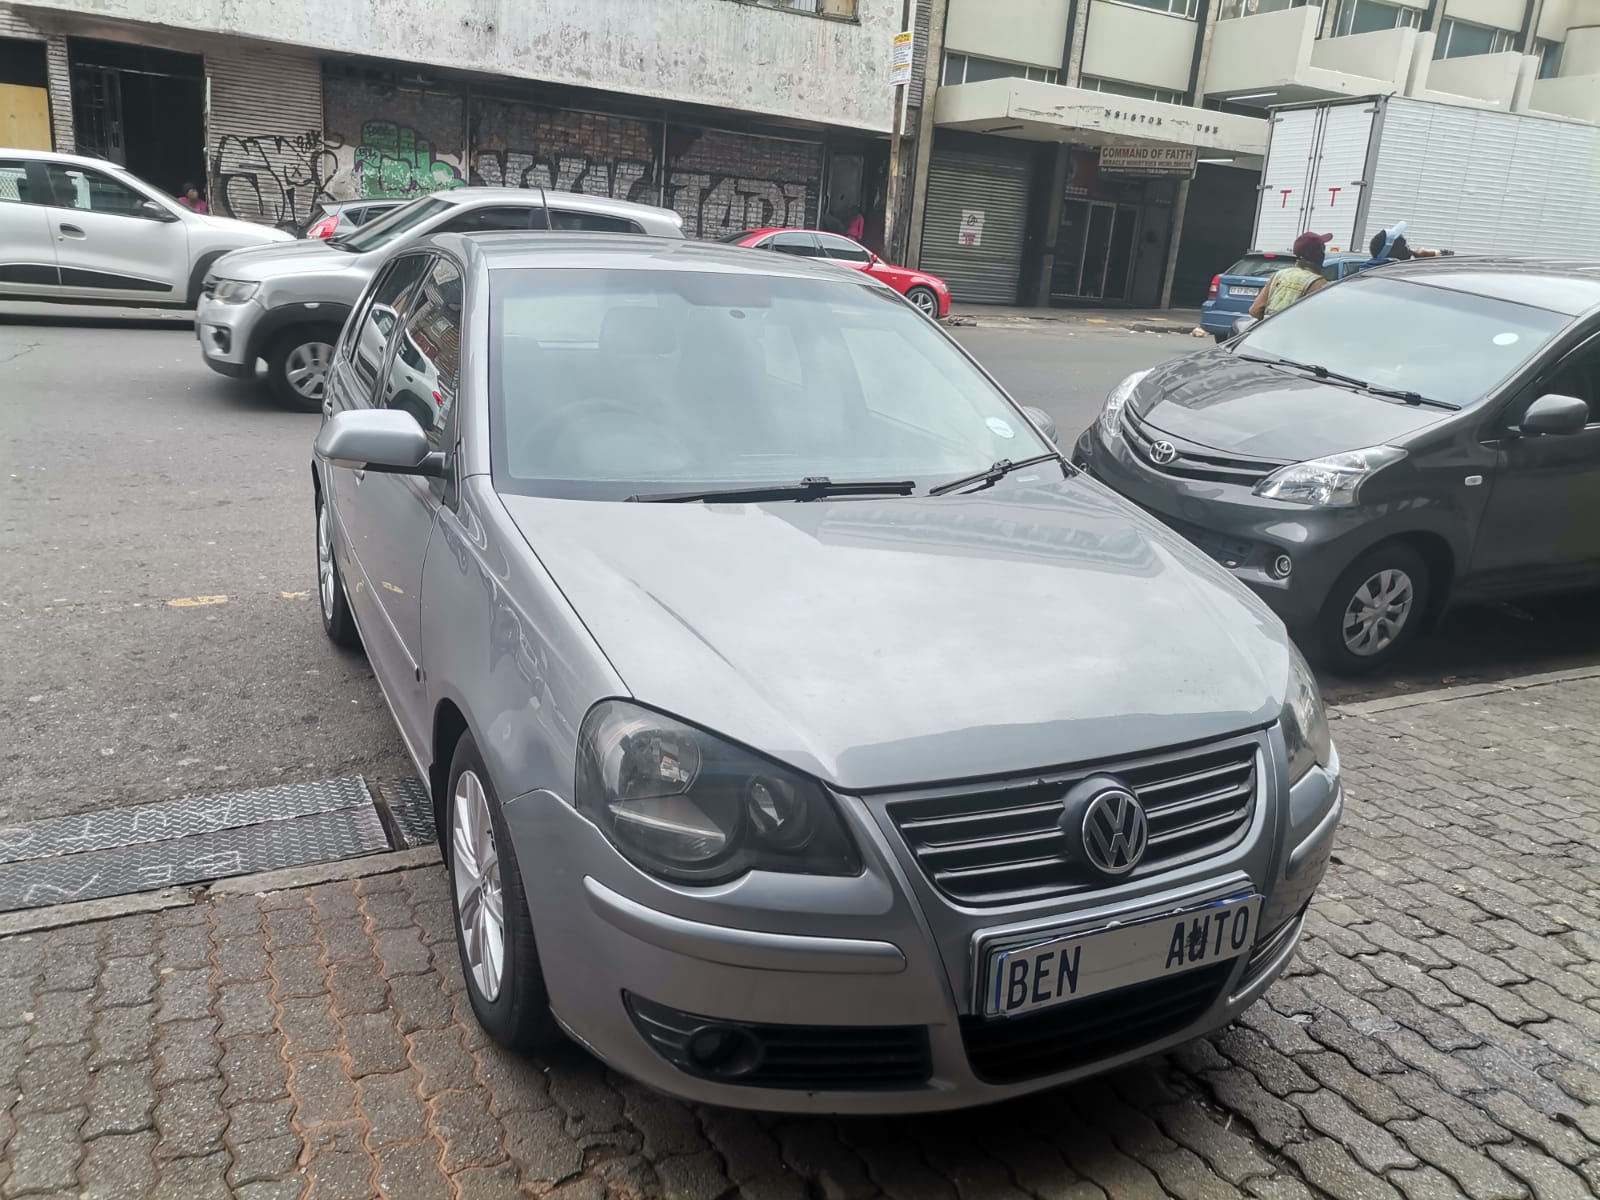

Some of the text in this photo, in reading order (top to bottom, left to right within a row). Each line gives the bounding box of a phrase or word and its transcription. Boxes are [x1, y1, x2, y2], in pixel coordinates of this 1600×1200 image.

[1102, 147, 1193, 161] COMMAND OF FAITH
[1280, 190, 1292, 208] T
[1329, 188, 1341, 206] T
[1007, 905, 1250, 1011] BEN AUTO
